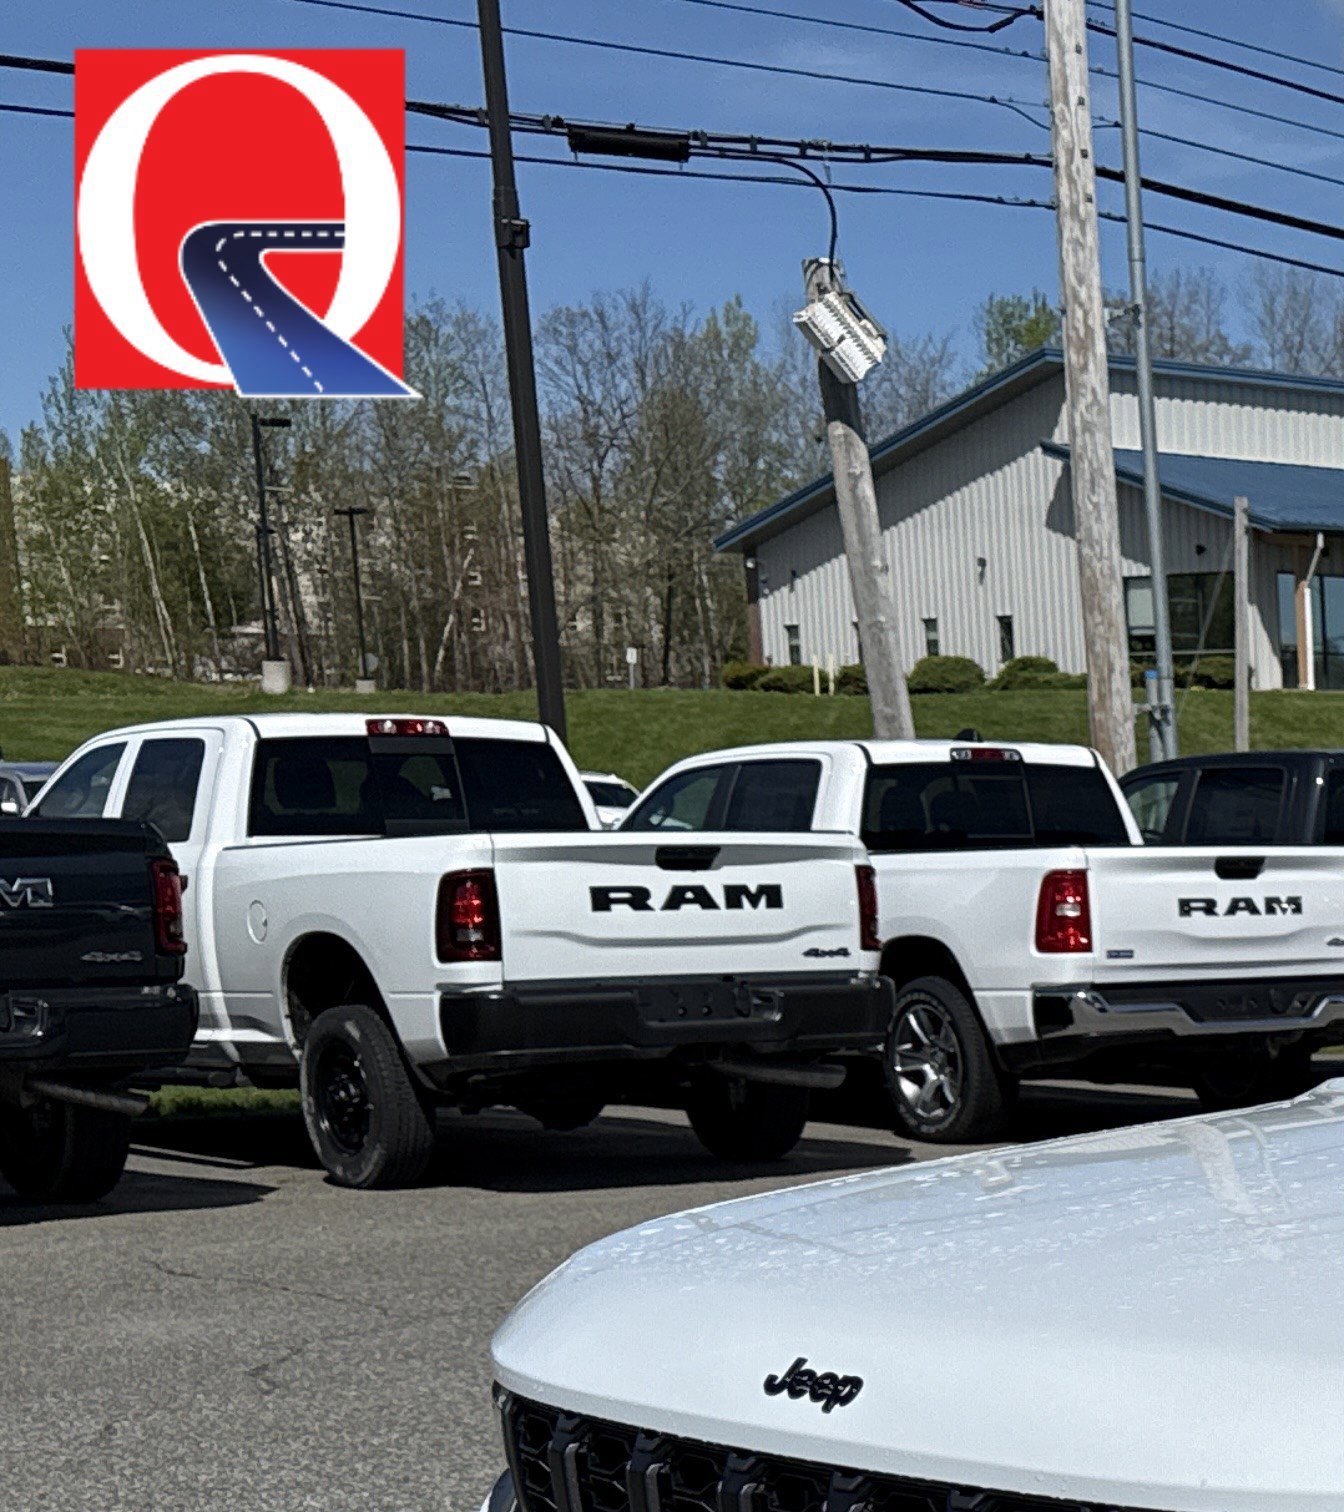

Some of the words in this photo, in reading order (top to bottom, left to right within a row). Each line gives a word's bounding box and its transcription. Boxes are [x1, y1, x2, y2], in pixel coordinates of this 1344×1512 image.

[589, 884, 784, 912] RAM
[1178, 896, 1303, 917] RAM
[763, 1356, 864, 1414] Jeep
